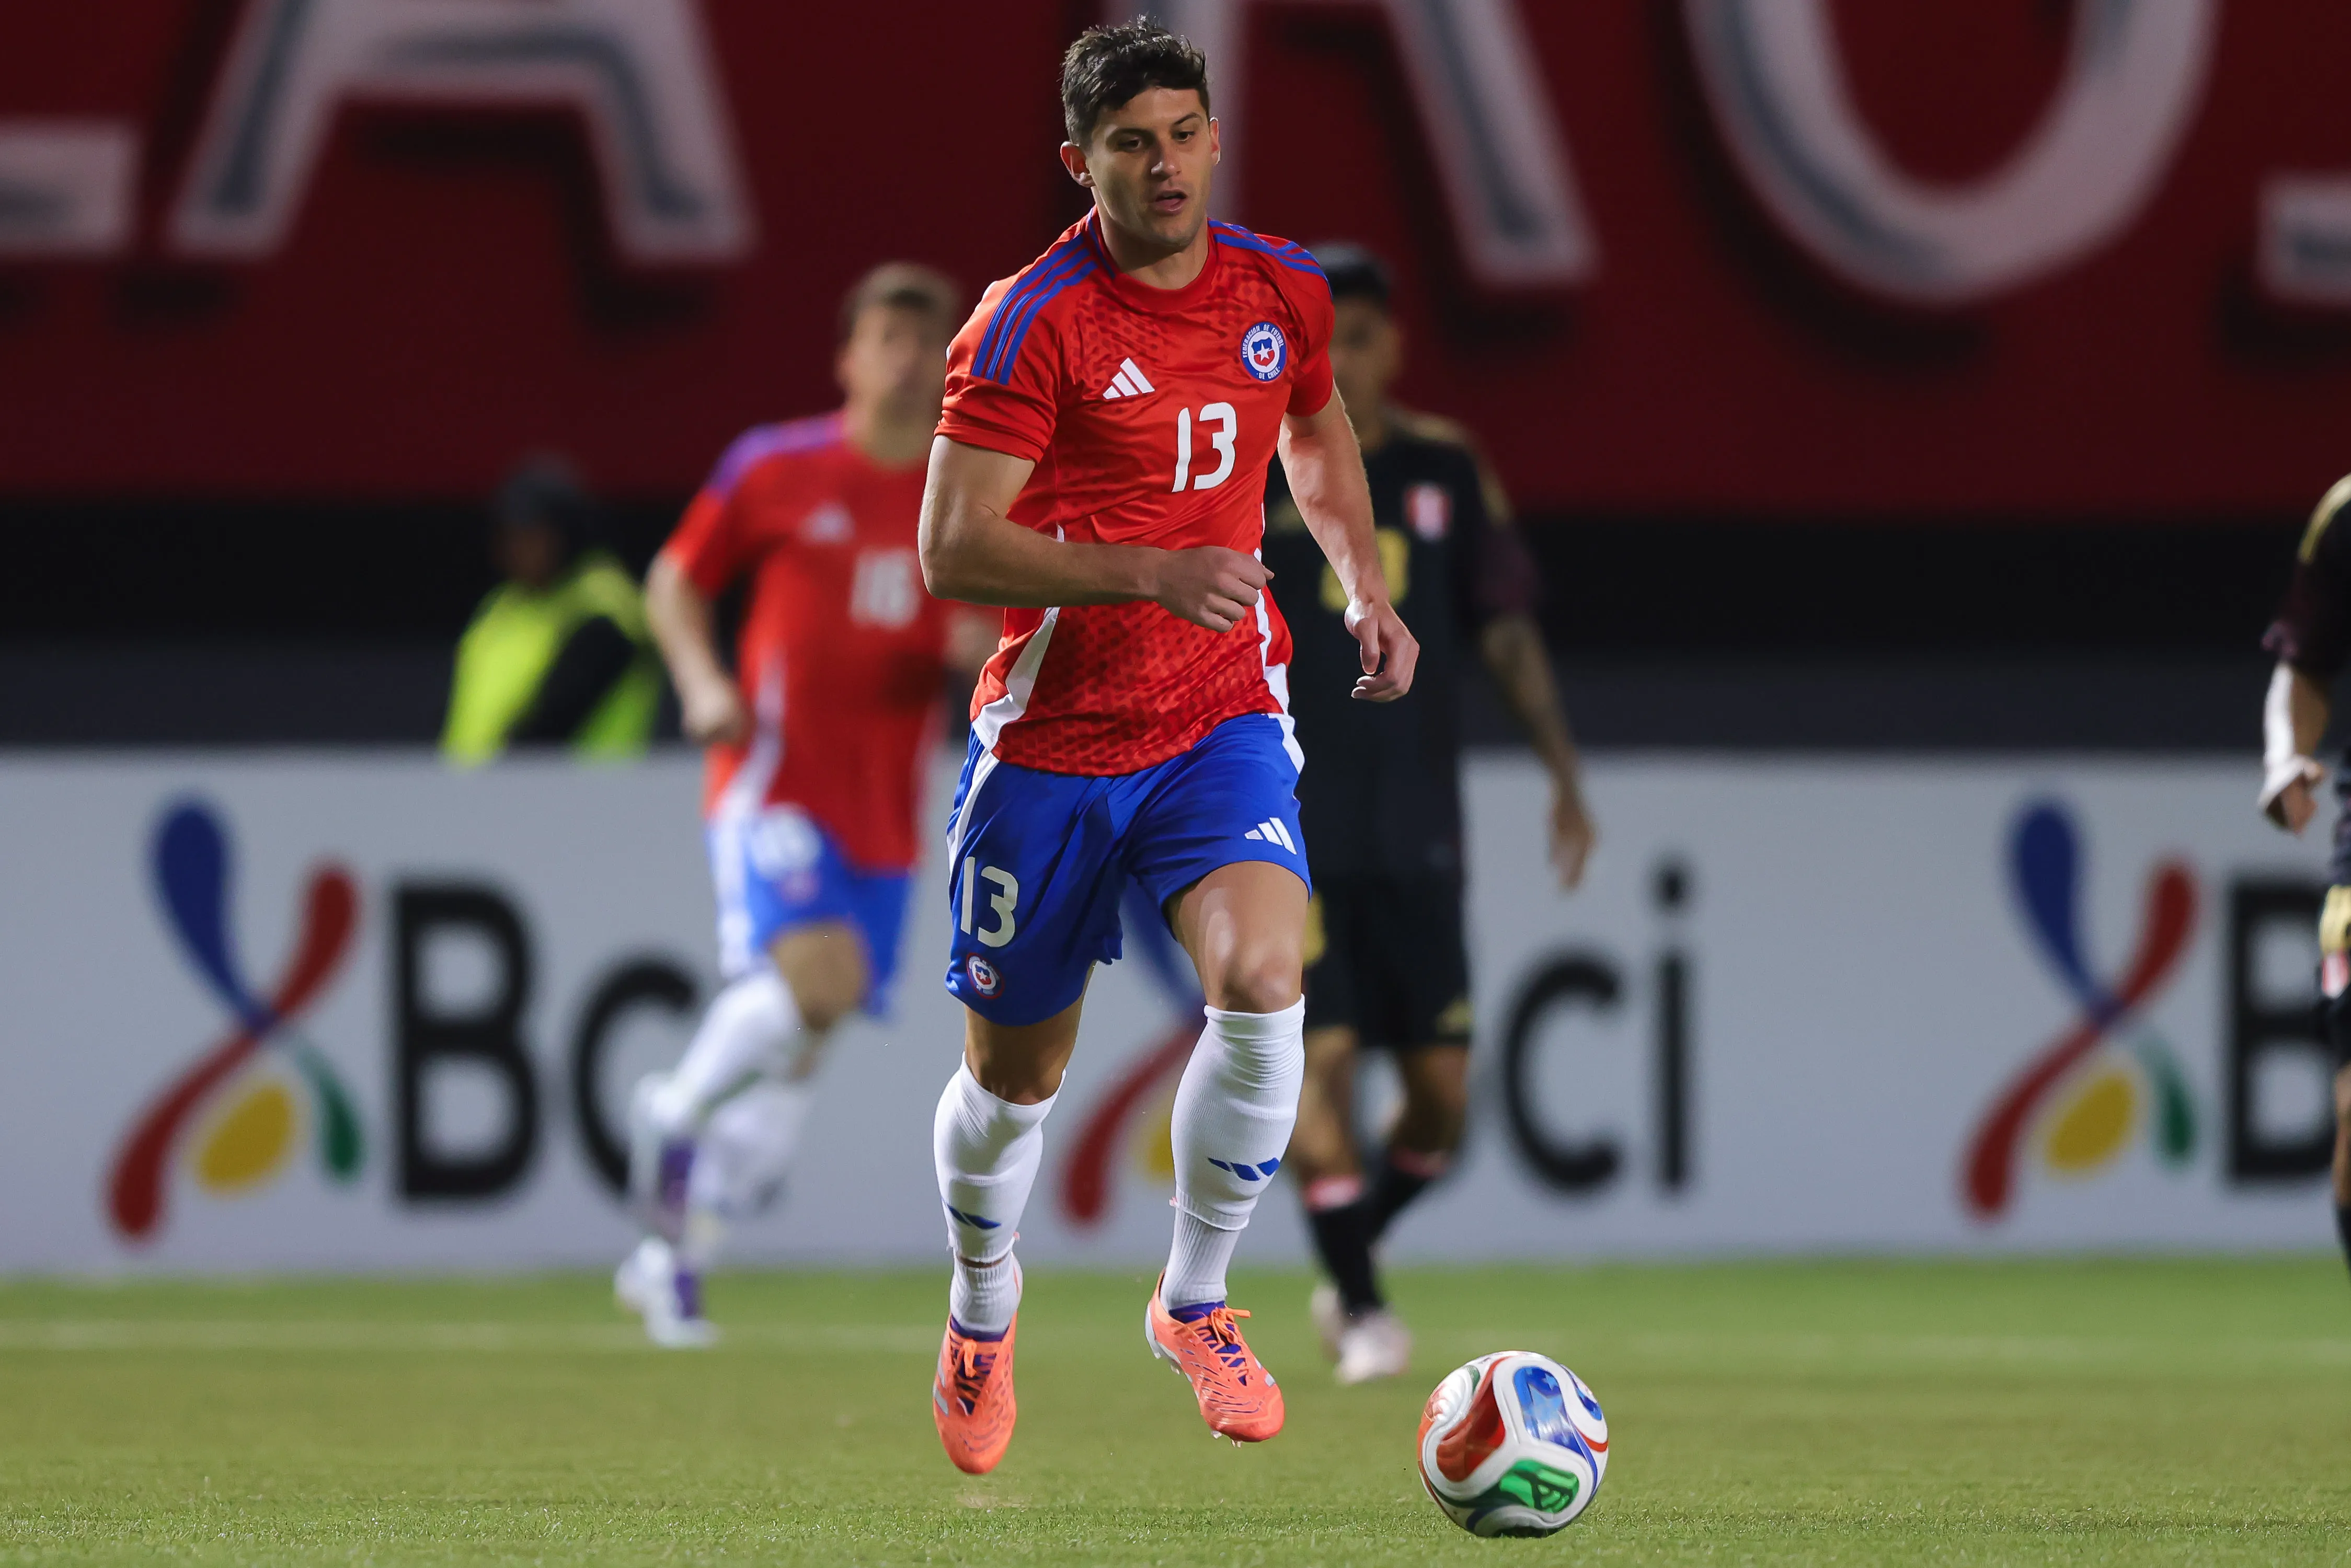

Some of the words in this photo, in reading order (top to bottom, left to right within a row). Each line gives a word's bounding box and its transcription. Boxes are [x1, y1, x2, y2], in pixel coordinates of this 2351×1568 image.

[1242, 325, 1260, 358] FEDERACION
[1271, 327, 1284, 348] FUTBOL
[1267, 367, 1280, 379] CHILE
[1172, 402, 1237, 493] 13
[960, 856, 1019, 948] 13
[391, 869, 699, 1208] Bc
[1501, 861, 1694, 1196] ci
